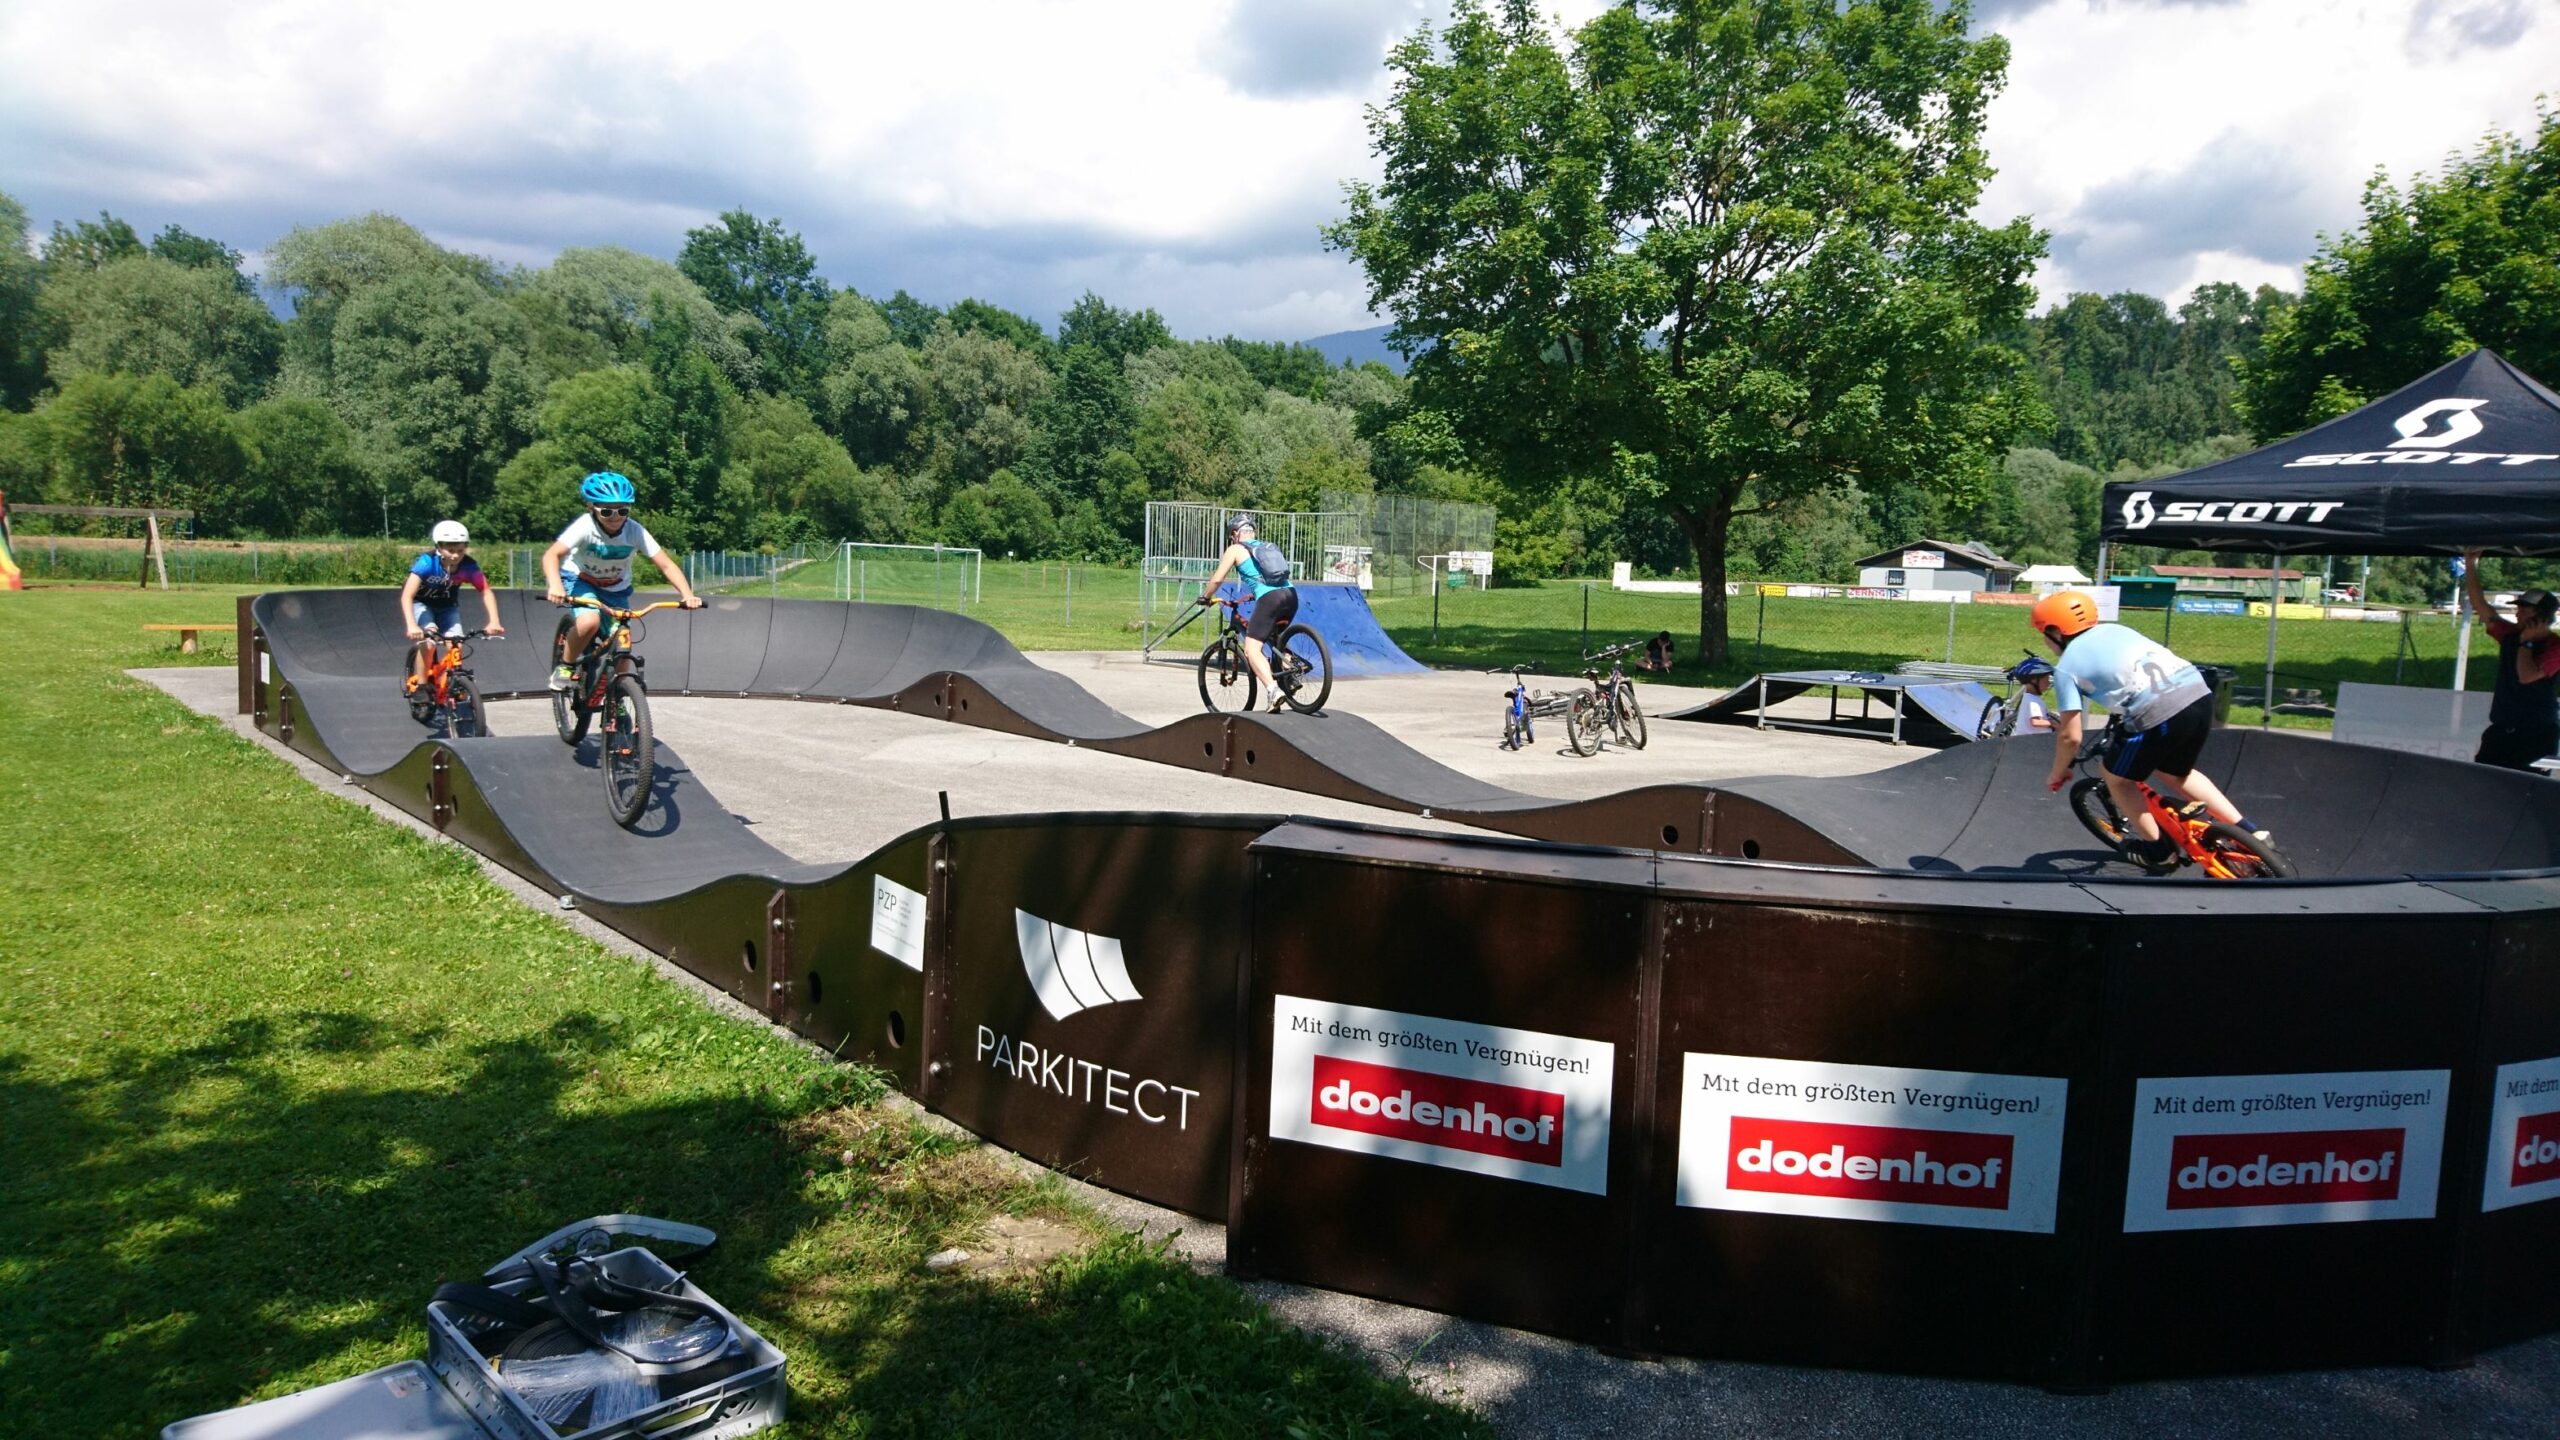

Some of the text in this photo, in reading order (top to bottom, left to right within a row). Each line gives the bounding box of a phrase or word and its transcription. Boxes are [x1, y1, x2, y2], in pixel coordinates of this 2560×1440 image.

[2283, 451, 2560, 467] SCOTT
[2157, 502, 2345, 523] SCOTT
[878, 888, 897, 912] PZP
[1291, 1015, 1591, 1075] Mit dem größten Vergnügen!
[976, 1024, 1200, 1131] PARKITECT
[1701, 1073, 2041, 1115] Mit dem größten Vergnügen!
[2507, 1079, 2559, 1098] Mit dem
[1320, 1079, 1554, 1145] dodenhof
[2153, 1089, 2431, 1117] Mit dem größten Vergnügen!
[1736, 1139, 2003, 1190] dodenhof
[2177, 1149, 2395, 1190] dodenhof
[2519, 1135, 2559, 1168] do
